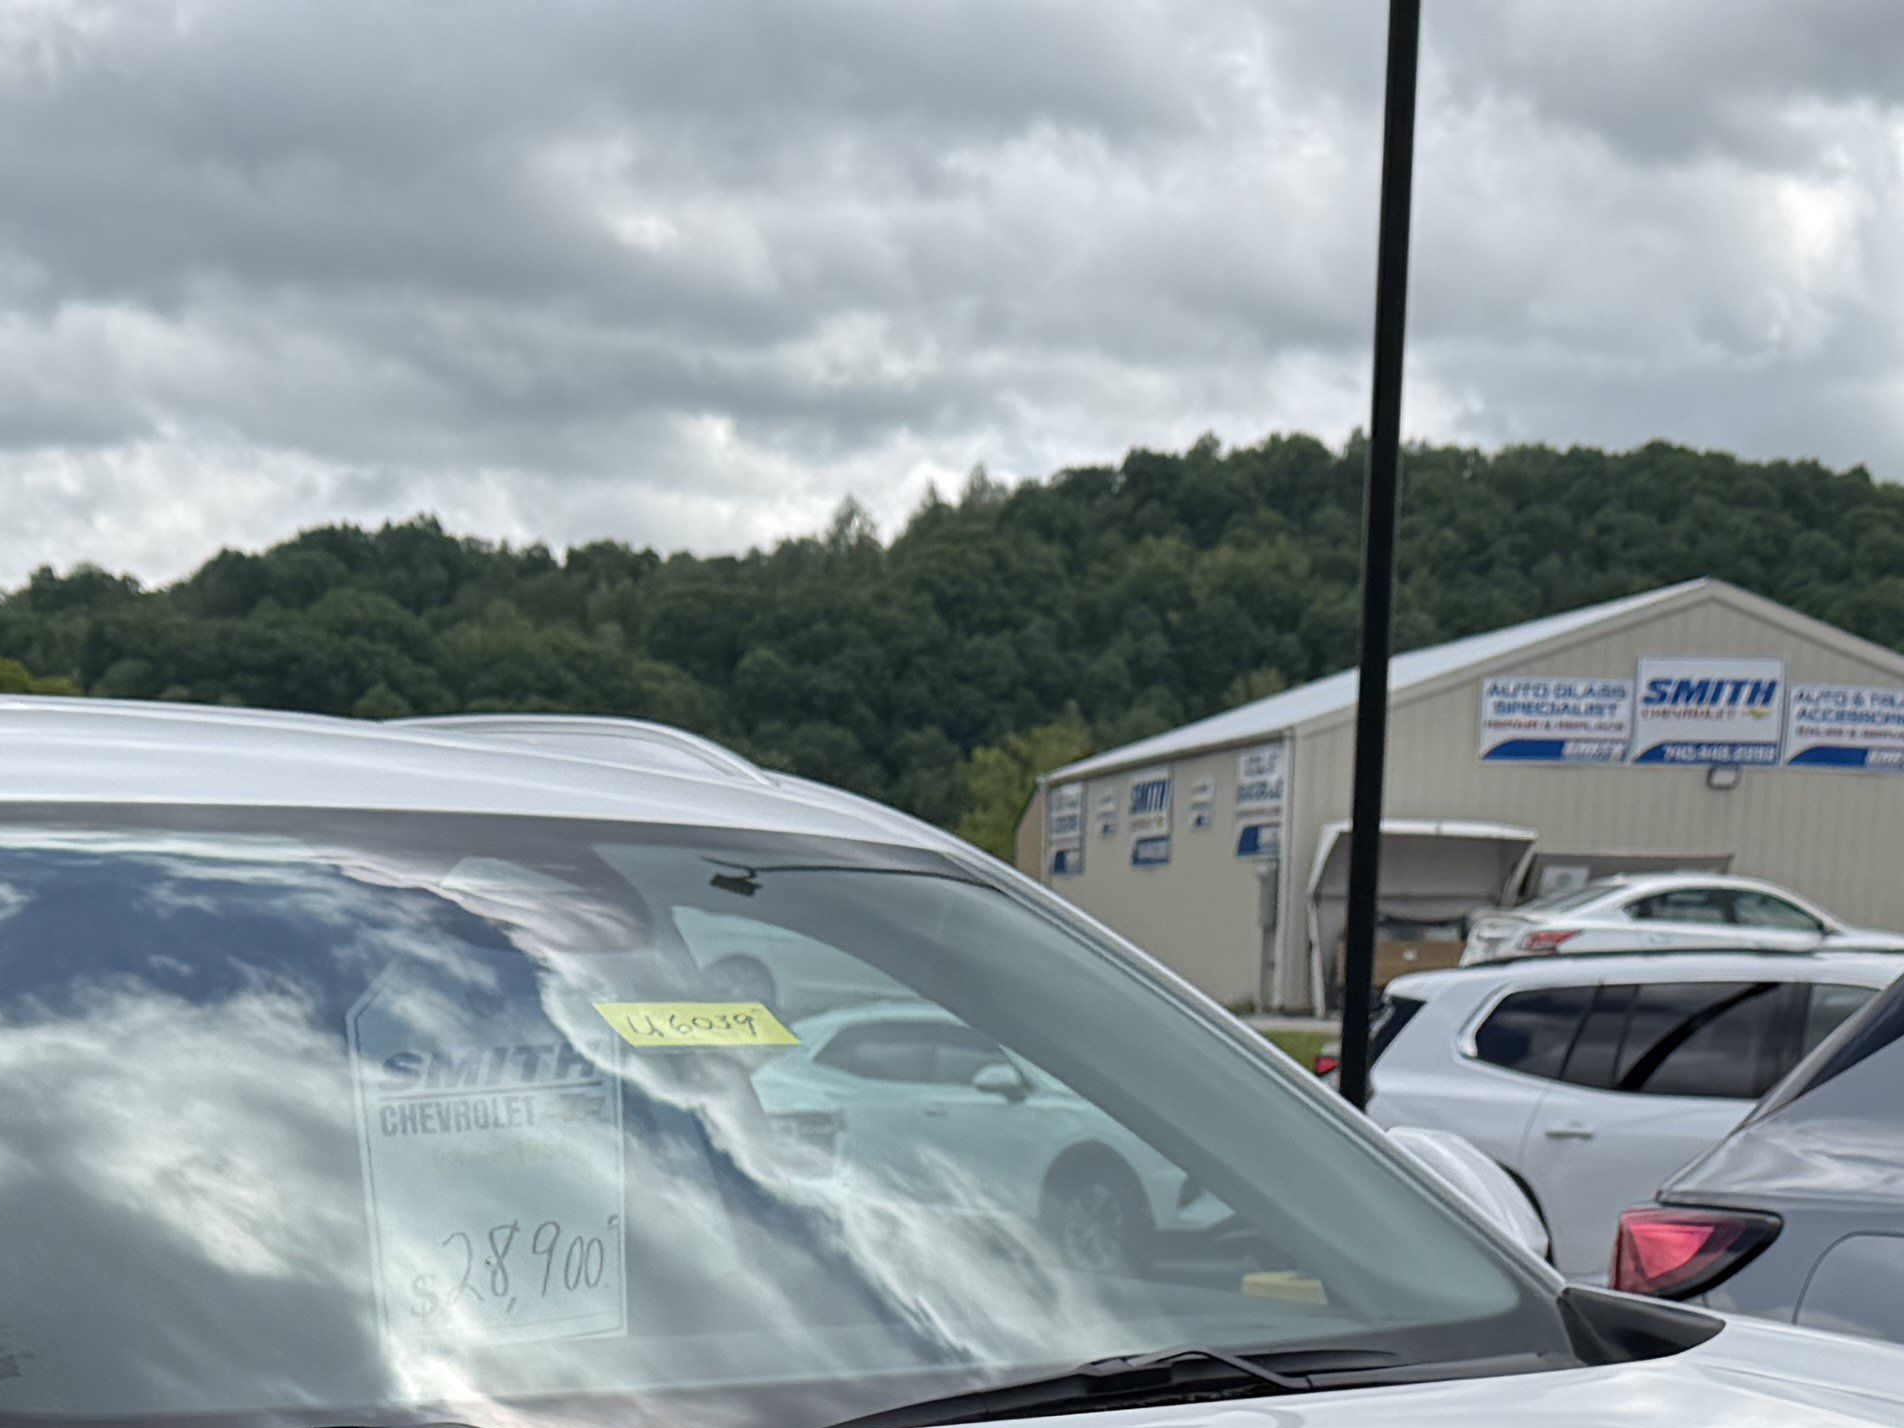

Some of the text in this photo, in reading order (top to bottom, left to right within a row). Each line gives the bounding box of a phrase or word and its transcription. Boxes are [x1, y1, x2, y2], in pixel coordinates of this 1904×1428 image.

[1487, 682, 1627, 698] AUTO GLASS
[1643, 678, 1778, 706] SMITH
[1795, 690, 1847, 706] AUTO
[1493, 700, 1617, 716] SPECIALIST
[379, 1041, 606, 1091] SMITH
[380, 1096, 536, 1136] CHEVROLET
